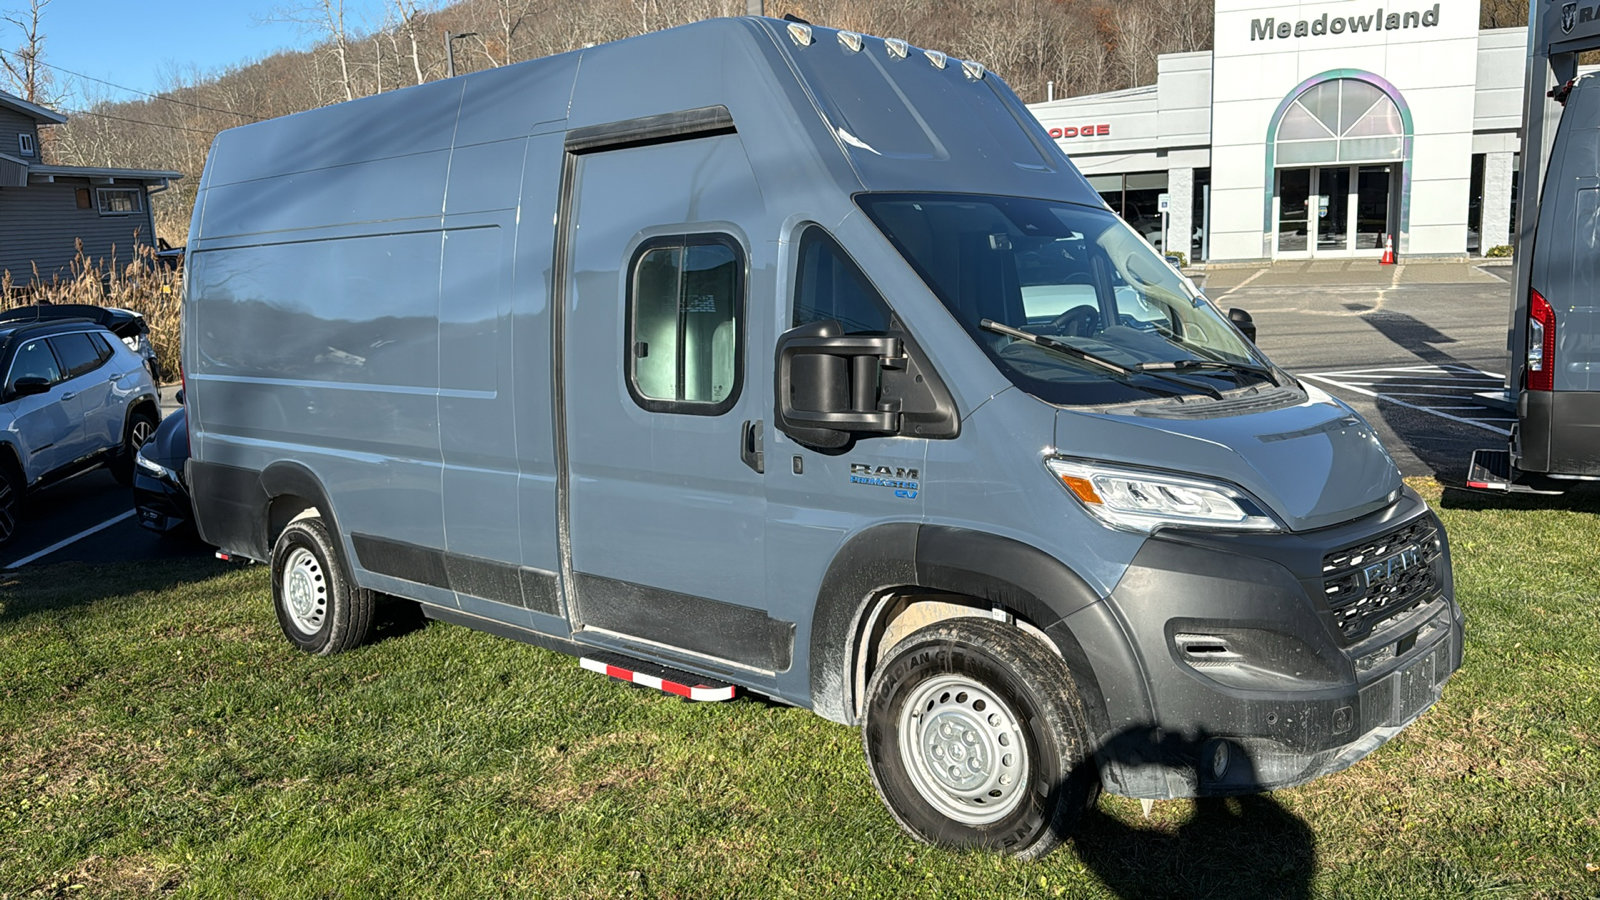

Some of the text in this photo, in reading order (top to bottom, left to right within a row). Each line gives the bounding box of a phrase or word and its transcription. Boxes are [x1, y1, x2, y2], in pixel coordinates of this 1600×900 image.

[1250, 3, 1440, 41] Meadowland
[1048, 124, 1110, 139] ODGE
[850, 463, 919, 480] RAM
[850, 475, 919, 491] PROMASTER
[1364, 546, 1418, 587] RAM
